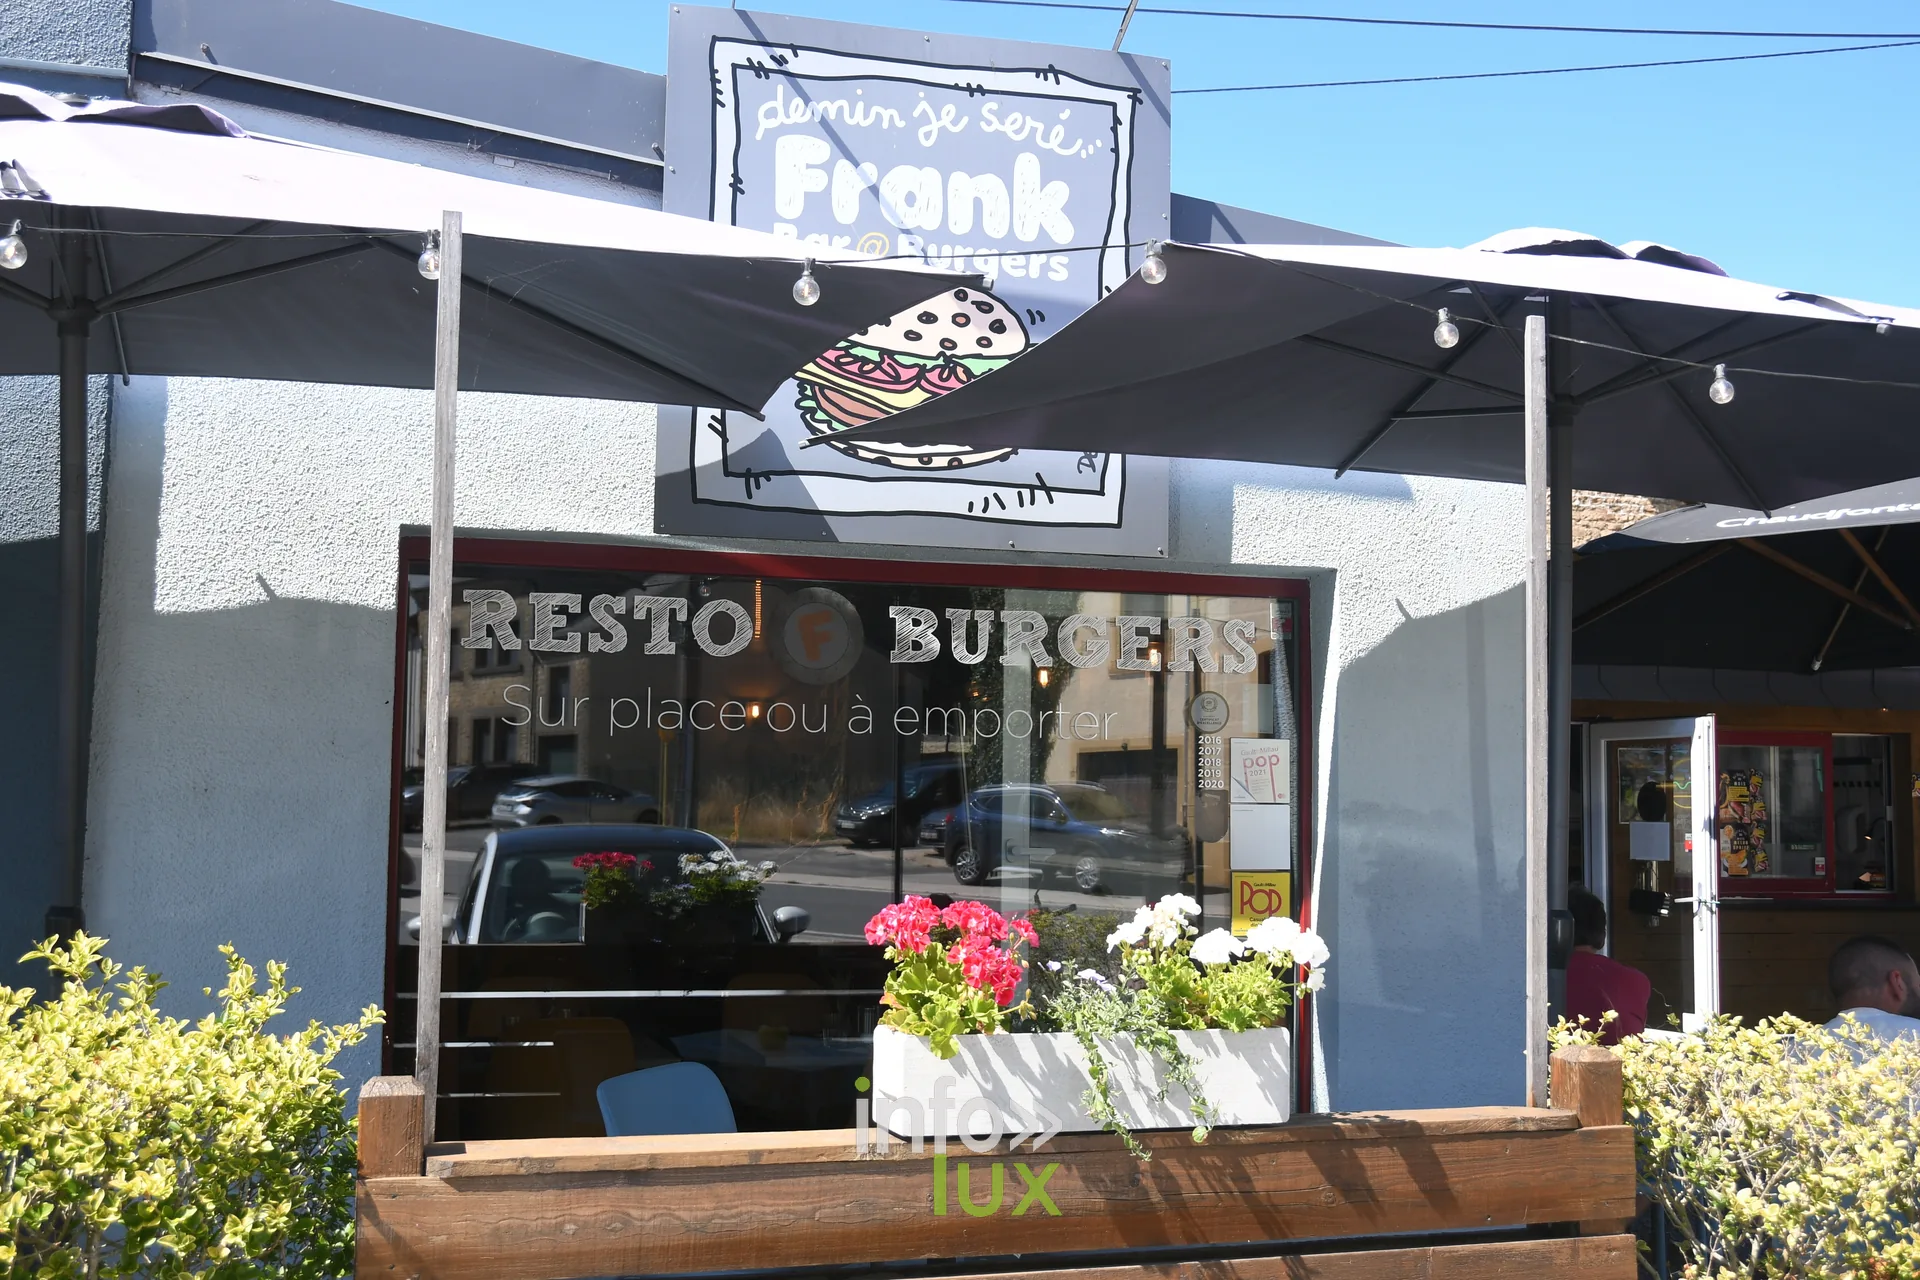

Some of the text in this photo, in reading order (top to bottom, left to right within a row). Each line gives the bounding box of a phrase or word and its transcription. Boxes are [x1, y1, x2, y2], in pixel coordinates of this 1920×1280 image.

[755, 84, 906, 140] demin
[913, 91, 969, 148] je
[775, 134, 1075, 245] Frank
[461, 589, 754, 657] RESTO
[797, 610, 833, 661] F
[889, 605, 1258, 674] BURGERS
[501, 684, 1119, 746] Sur place ou à emporter
[1198, 735, 1222, 745] 2016
[1198, 746, 1222, 755] 2017
[1198, 757, 1222, 767] 2018
[1198, 768, 1222, 778] 2019
[1249, 769, 1267, 777] 2021
[1198, 779, 1225, 789] 2020
